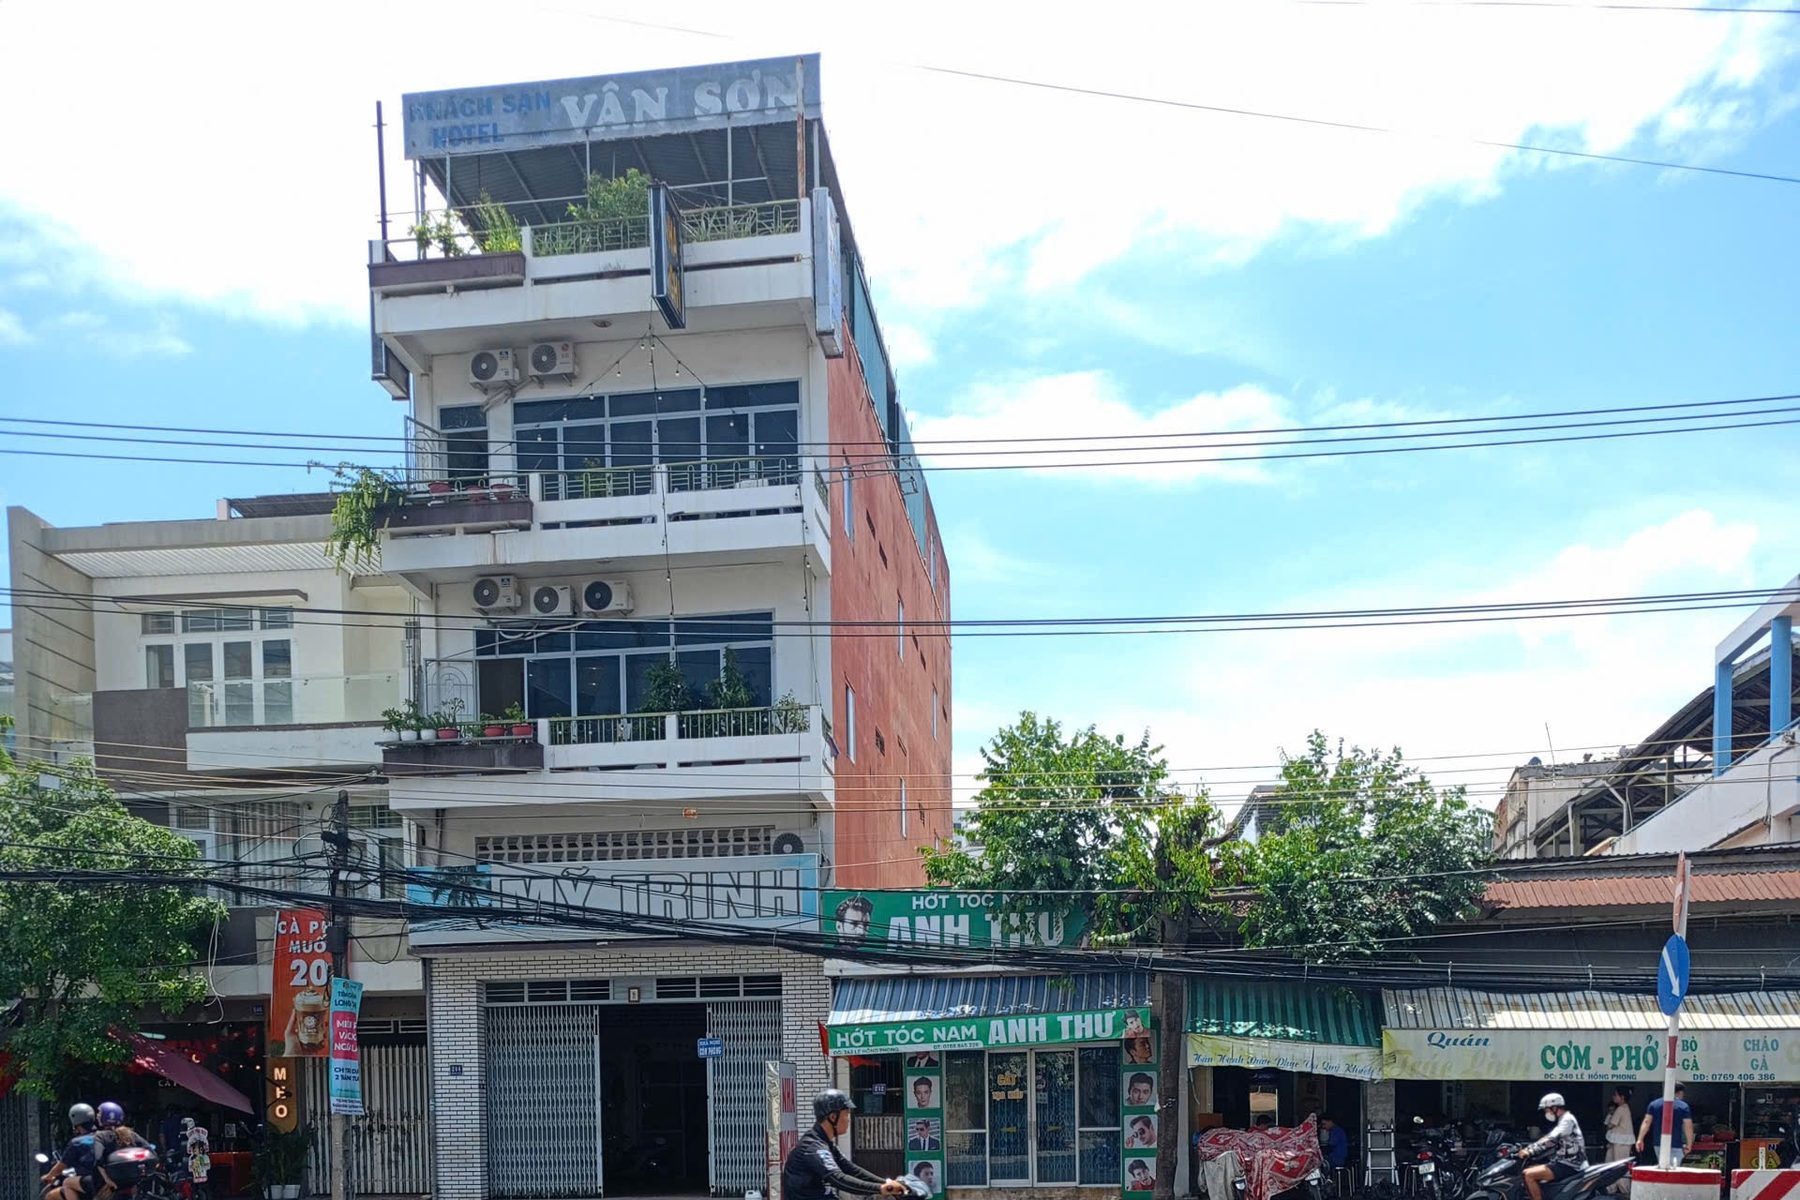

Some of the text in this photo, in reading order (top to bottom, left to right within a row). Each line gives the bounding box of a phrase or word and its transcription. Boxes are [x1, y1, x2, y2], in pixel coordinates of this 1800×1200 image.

[561, 69, 799, 133] VÂN SƠN
[432, 122, 505, 149] HOTEL
[611, 868, 800, 923] TRINH
[912, 893, 950, 910] HỚT
[278, 916, 300, 934] CÀ
[887, 914, 970, 950] ANH
[289, 934, 327, 953] MUỐ
[836, 1011, 1116, 1047] HỚT TÓC NAM ANH THƯ
[1428, 1031, 1490, 1049] Quán
[1682, 1036, 1698, 1051] BÒ
[1541, 1040, 1591, 1070] CƠM
[1610, 1034, 1659, 1070] PHỞ
[1682, 1055, 1699, 1070] GÀ
[1751, 1055, 1769, 1070] GÀ
